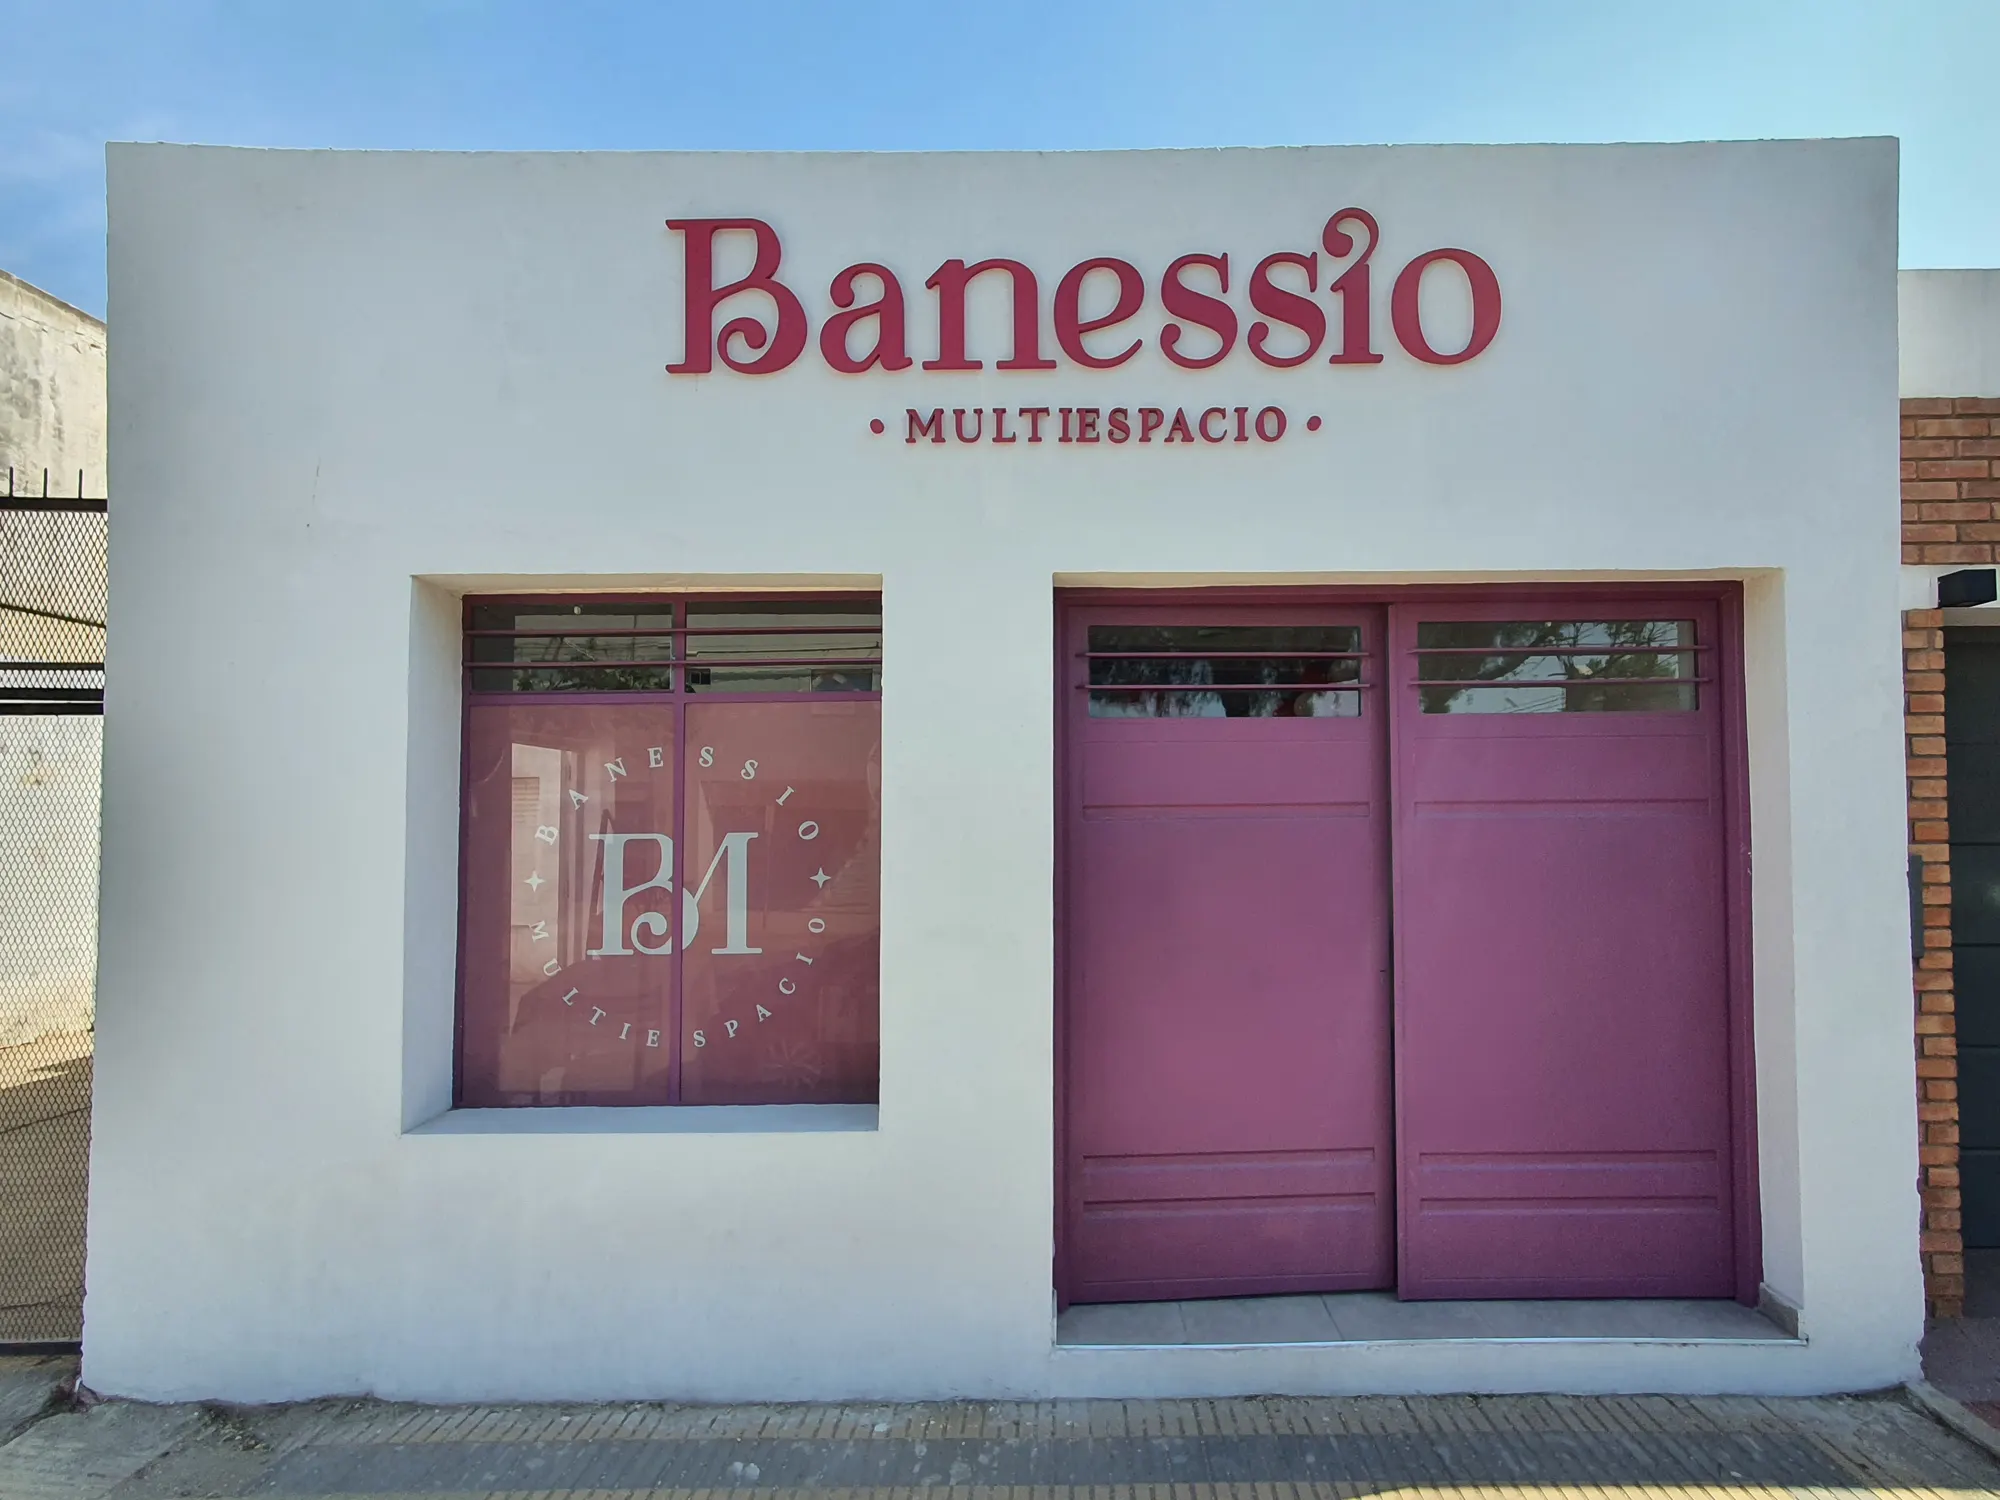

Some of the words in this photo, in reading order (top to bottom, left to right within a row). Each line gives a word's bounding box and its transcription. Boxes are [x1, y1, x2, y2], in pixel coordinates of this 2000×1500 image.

[665, 207, 1502, 375] Banessio
[904, 405, 1288, 444] MULTIESPACIO
[534, 745, 819, 846] BANESSIO
[528, 917, 826, 1048] MULTIESPACIO
